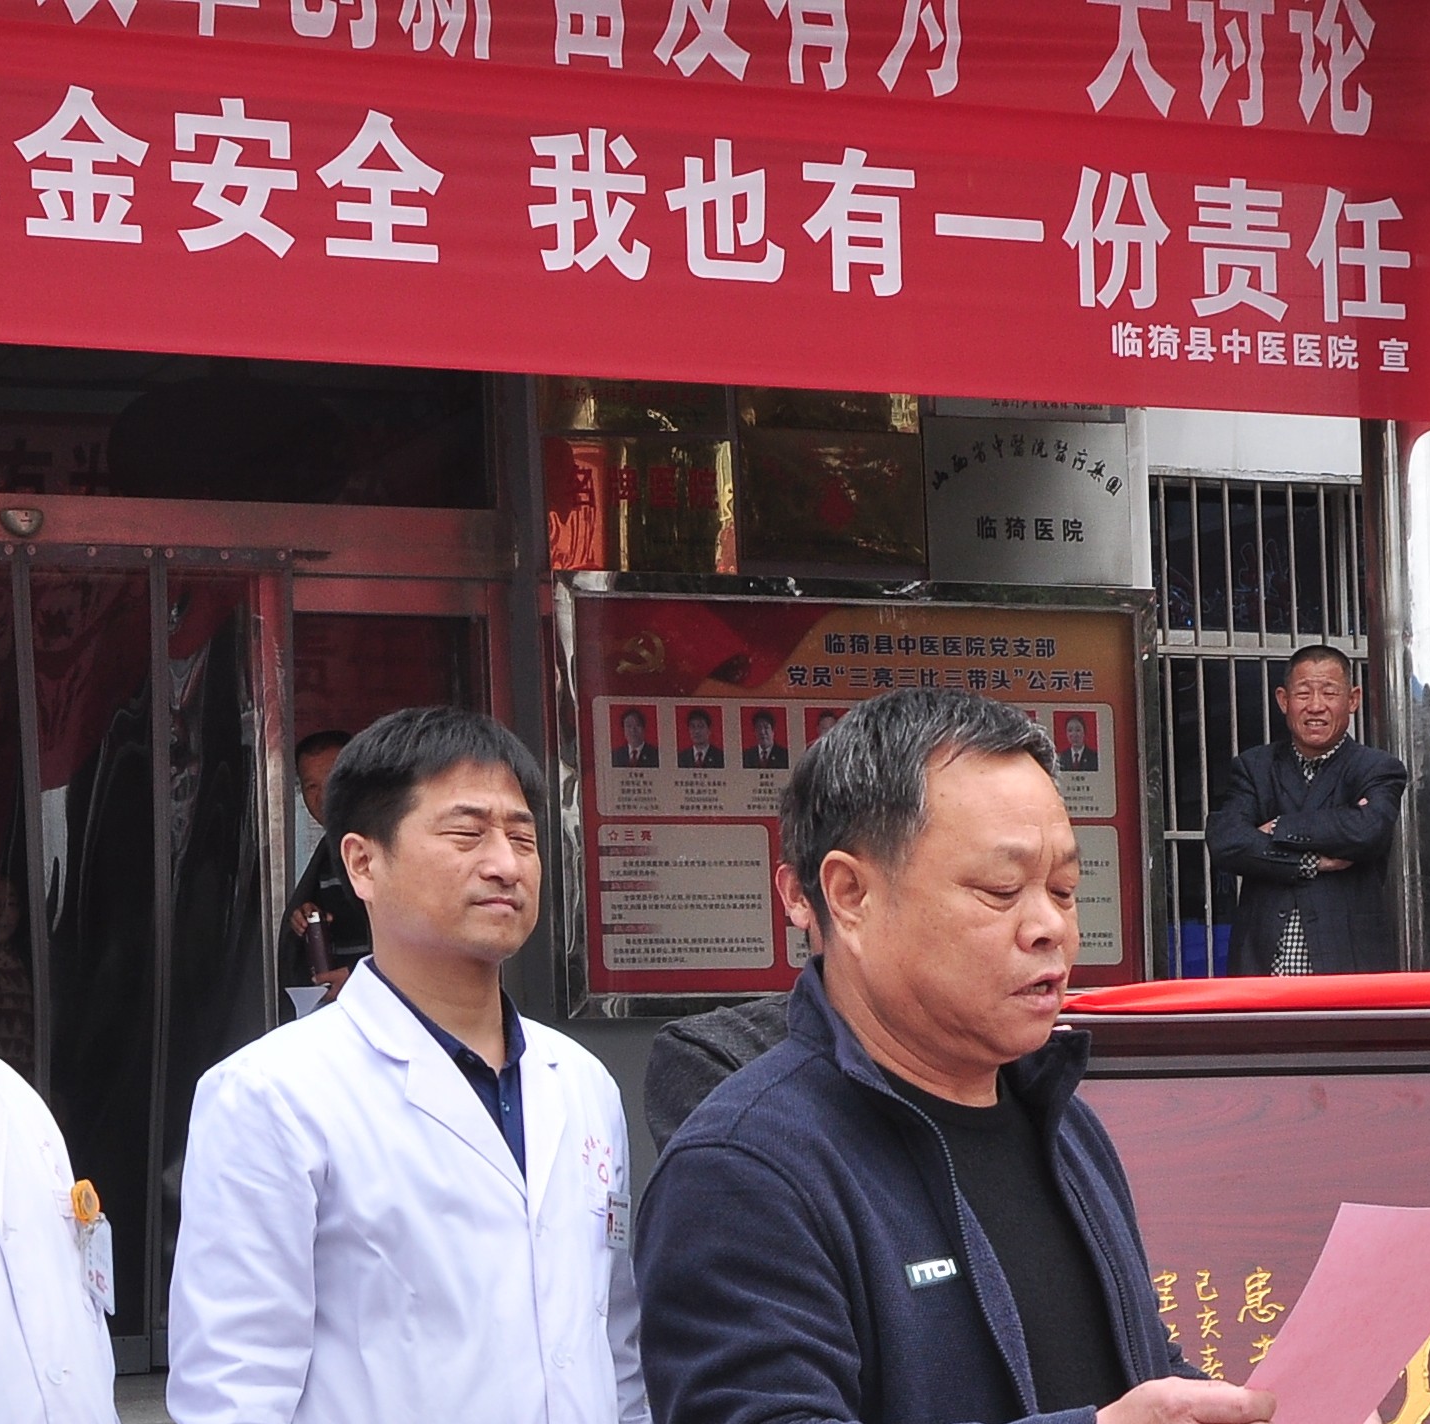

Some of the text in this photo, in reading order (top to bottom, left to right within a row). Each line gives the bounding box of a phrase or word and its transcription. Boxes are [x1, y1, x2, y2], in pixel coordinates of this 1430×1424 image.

[528, 128, 1413, 324] 我也有一份责任
[1111, 321, 1411, 373] 临猗县中医医院 宣
[976, 515, 1085, 543] 临猗医院
[824, 632, 1057, 660] 临猗县中医医院党支部
